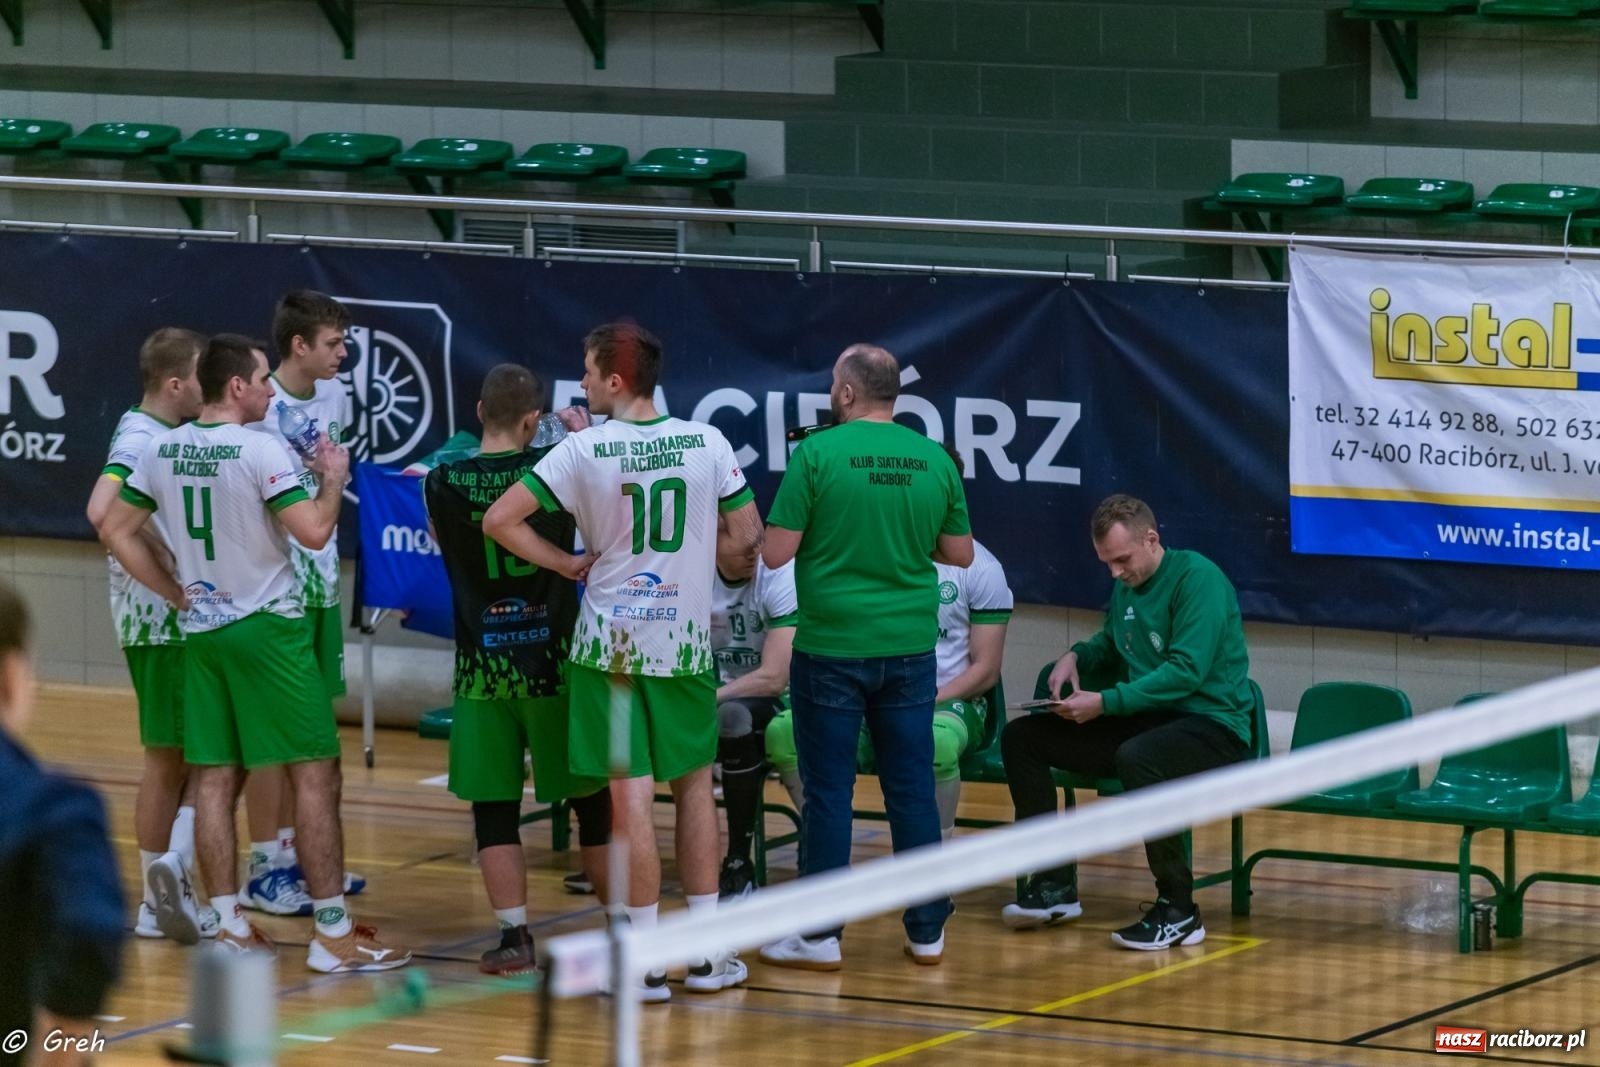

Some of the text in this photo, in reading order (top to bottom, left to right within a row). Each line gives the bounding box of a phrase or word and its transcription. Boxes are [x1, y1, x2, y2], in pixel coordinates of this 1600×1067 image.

[1369, 287, 1578, 390] instal
[1315, 403, 1348, 424] tel.
[1354, 407, 1379, 427] 32
[1388, 408, 1432, 430] 414
[1440, 411, 1466, 431] 92
[1472, 412, 1504, 436] 88,
[1516, 417, 1557, 437] 502
[0, 420, 66, 461] ÓRZ
[594, 433, 706, 458] KLUB SIATKARSKI
[620, 451, 685, 473] RACIBÓRZ
[849, 456, 928, 472] KLUB SIATKARSKI
[1331, 440, 1411, 463] 47-400
[1420, 443, 1524, 472] Racibórz,
[1530, 451, 1556, 472] ul.
[448, 470, 478, 487] KLUB
[869, 471, 912, 486] RACIBÓRZ
[182, 485, 215, 561] 4
[621, 477, 687, 555] 10
[1437, 522, 1600, 552] www.instal-
[616, 588, 679, 598] UBEZPIECZENIA
[612, 605, 677, 618] ENTECO
[728, 613, 746, 636] 13
[483, 627, 550, 647] ENTECO
